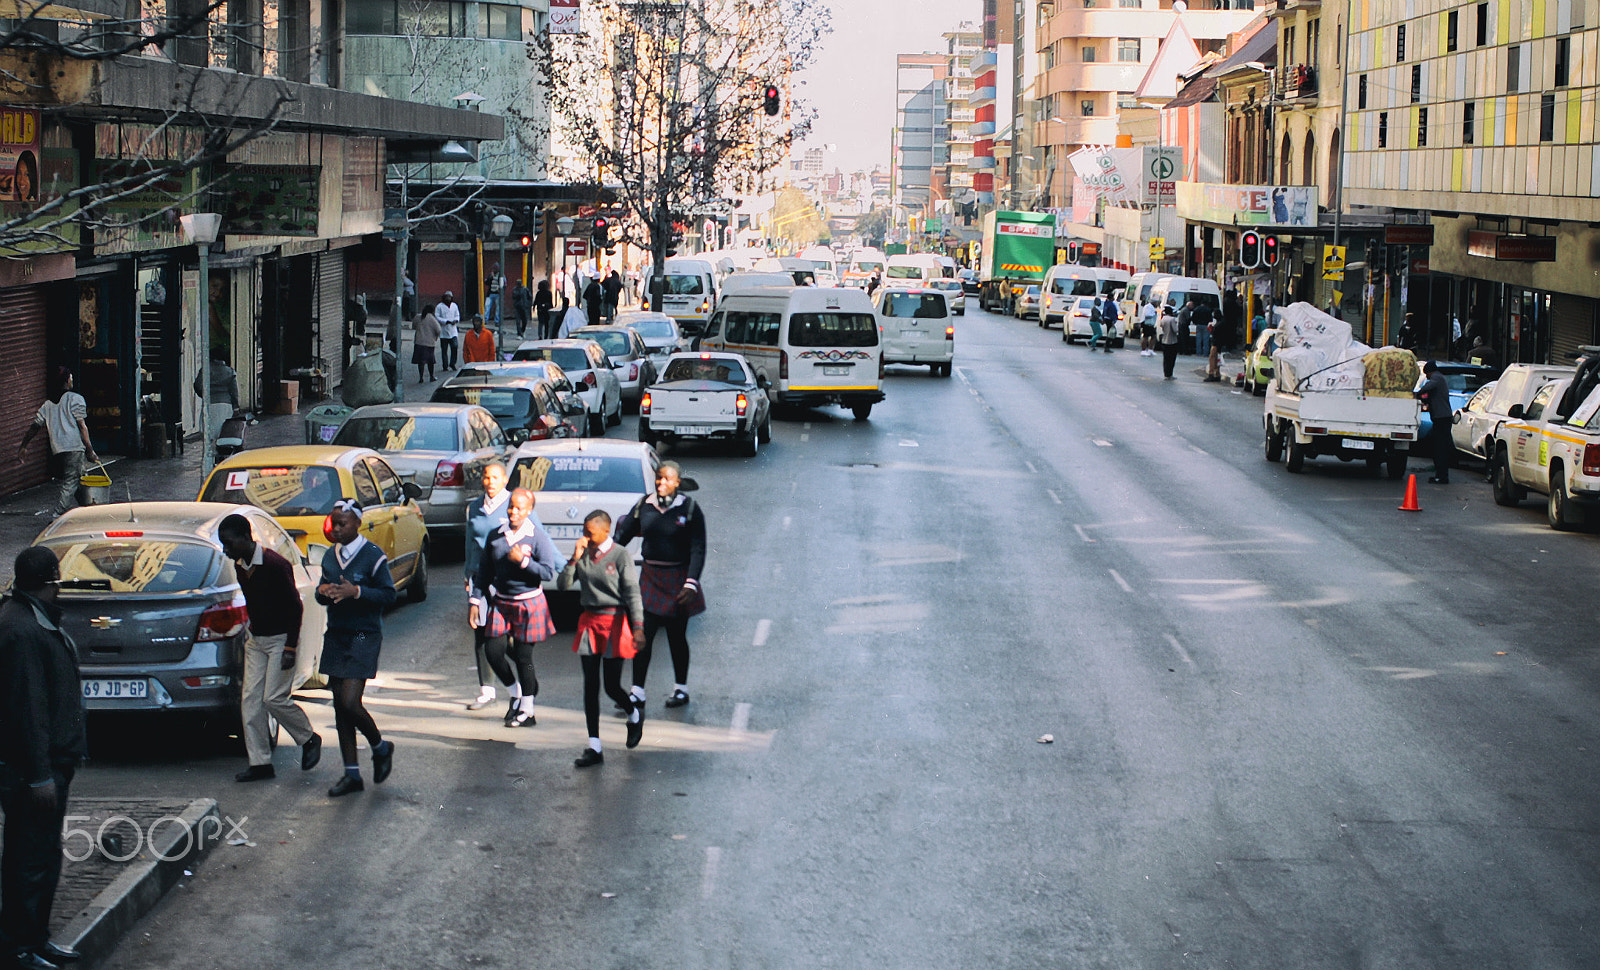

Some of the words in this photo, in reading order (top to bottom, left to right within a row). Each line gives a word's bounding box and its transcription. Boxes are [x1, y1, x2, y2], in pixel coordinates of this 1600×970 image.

[0, 111, 35, 145] RLD
[230, 474, 243, 487] L
[83, 682, 100, 696] 69
[105, 682, 121, 696] JD
[129, 681, 145, 696] GP
